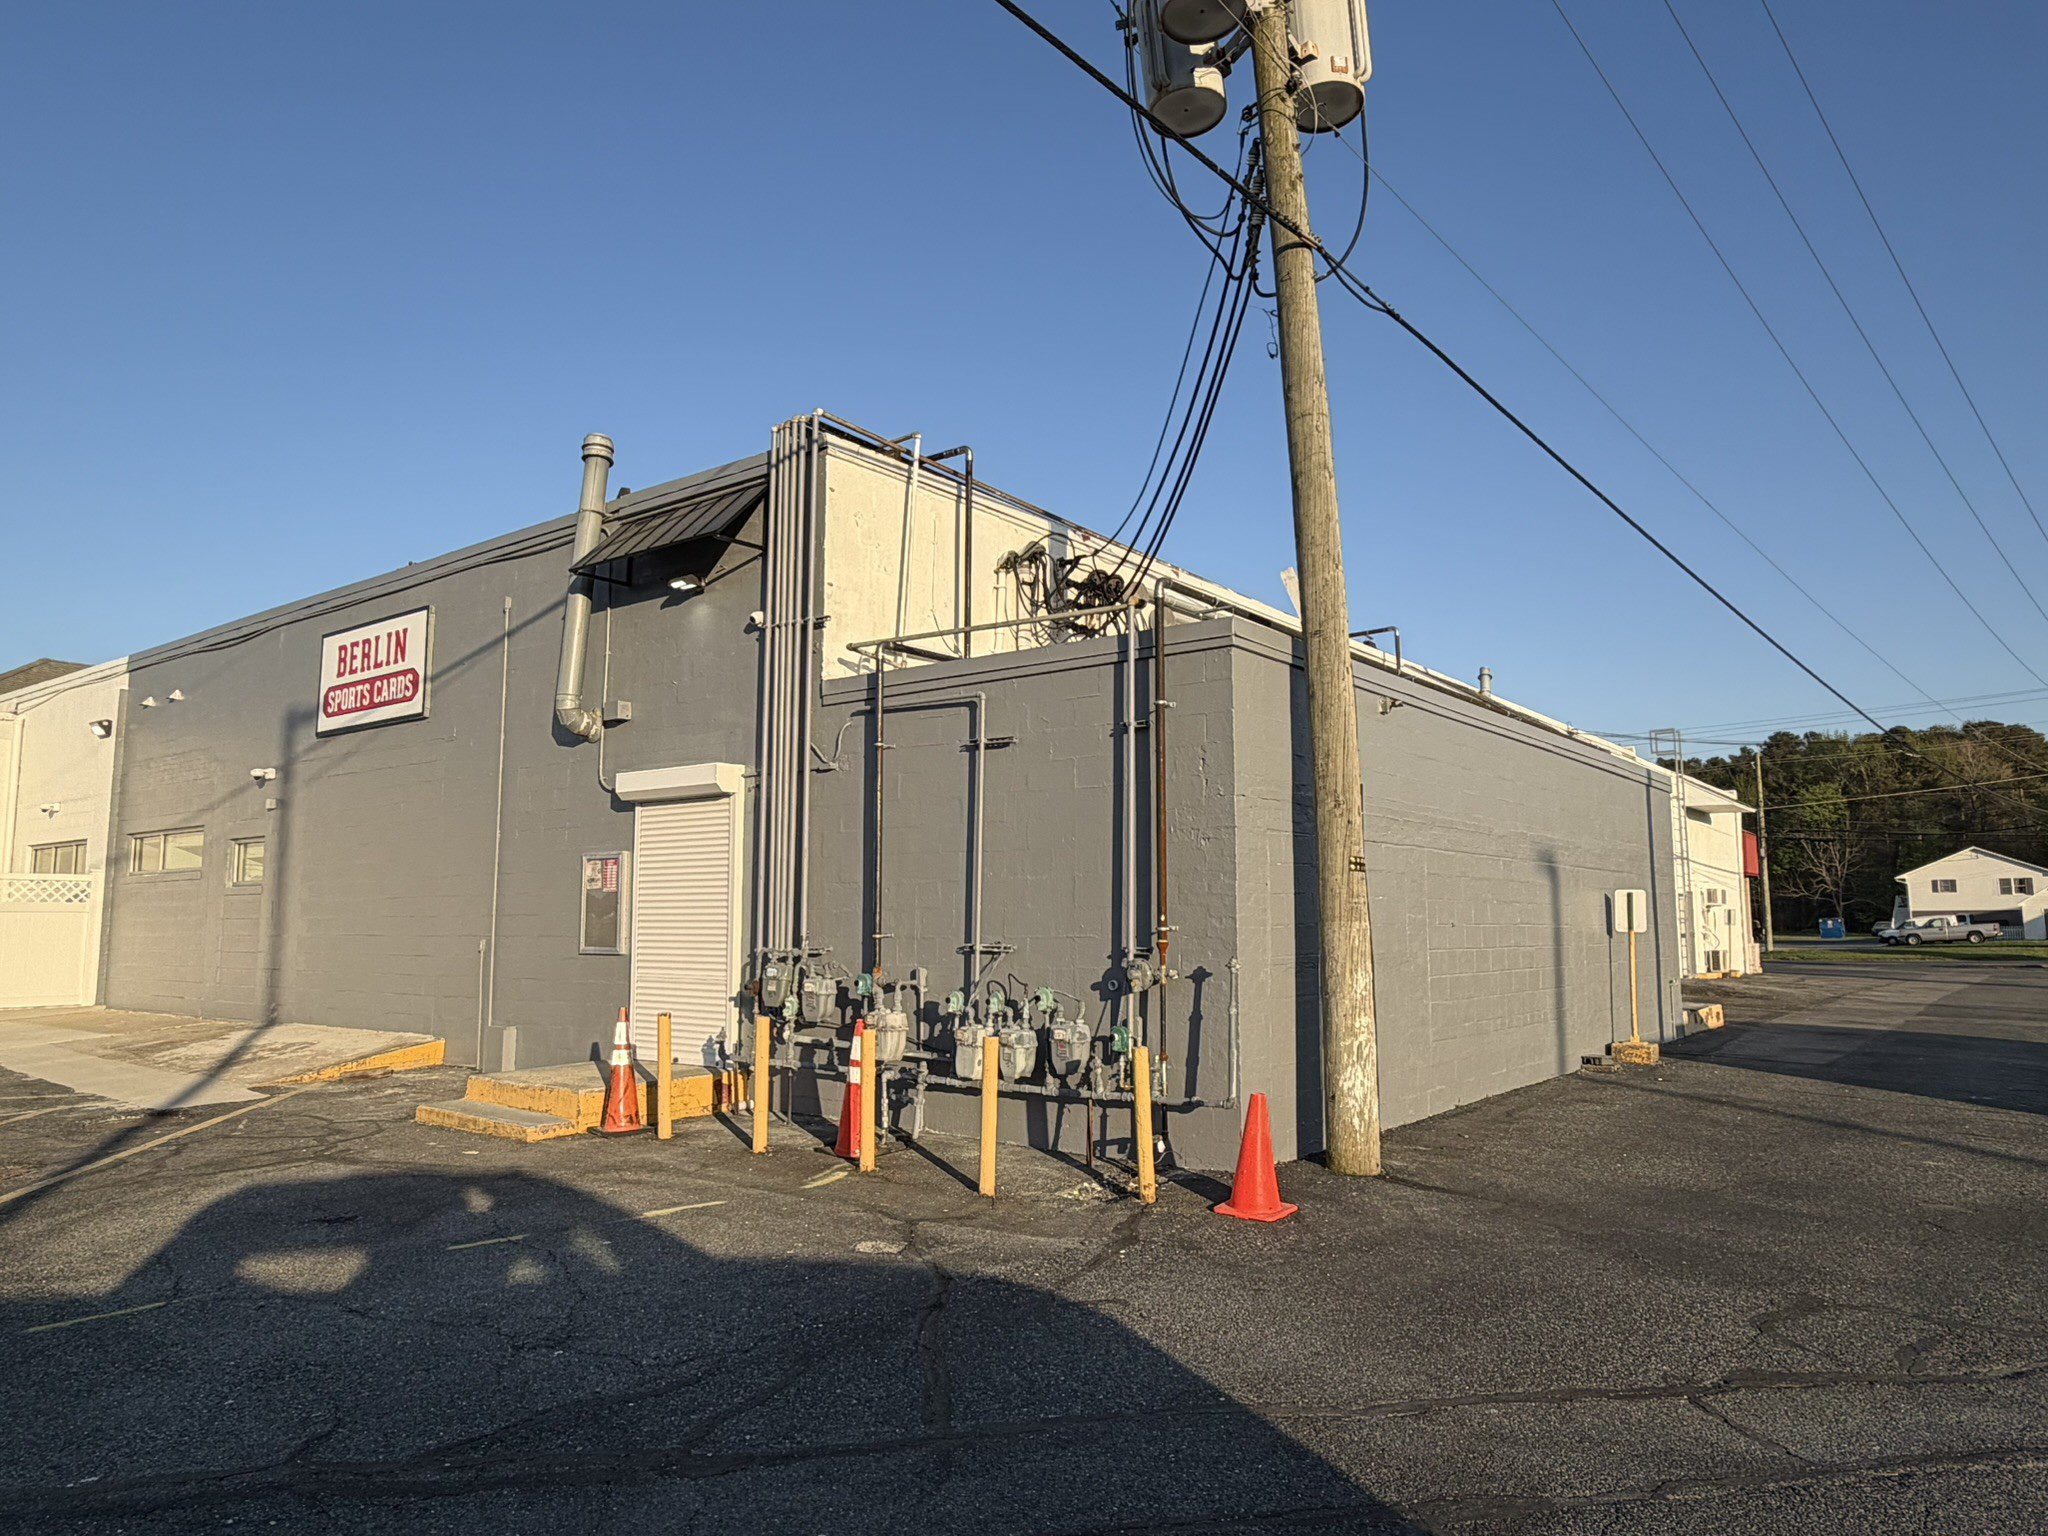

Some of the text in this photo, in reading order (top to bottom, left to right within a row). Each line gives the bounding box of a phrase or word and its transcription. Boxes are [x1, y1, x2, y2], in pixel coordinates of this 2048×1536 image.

[336, 628, 408, 678] BERLIN
[327, 673, 413, 713] SPORTS CARDS
